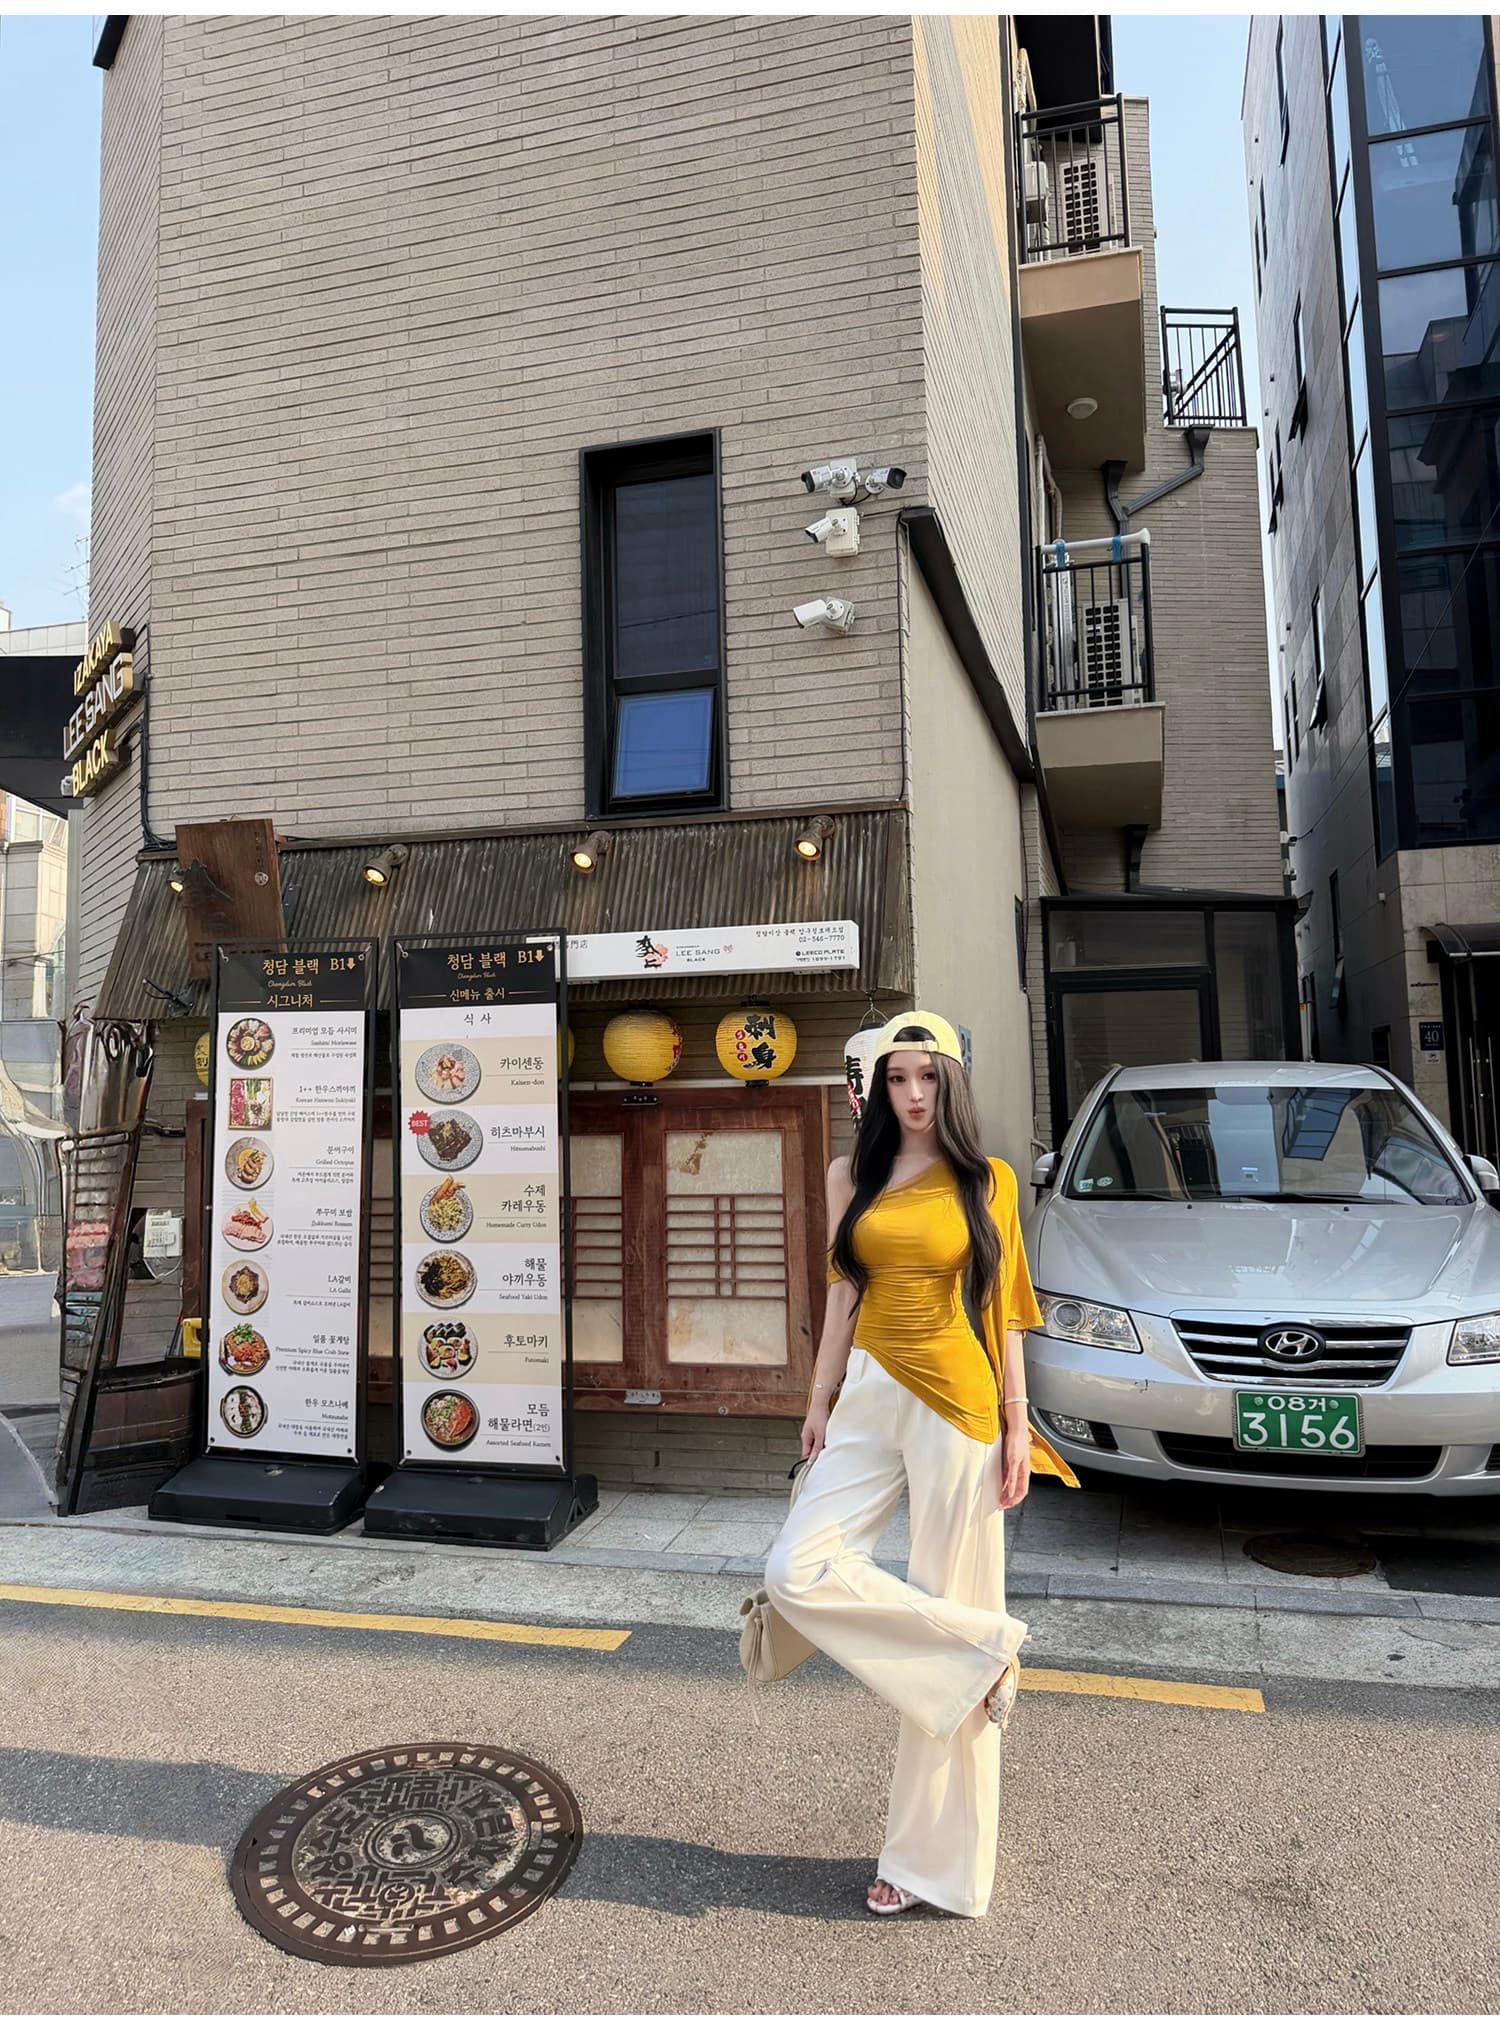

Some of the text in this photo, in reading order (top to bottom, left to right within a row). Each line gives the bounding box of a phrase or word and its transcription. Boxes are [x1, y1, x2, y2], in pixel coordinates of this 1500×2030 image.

[74, 621, 113, 695] IZAKAYA
[72, 729, 109, 797] BLACK
[695, 948, 720, 956] SANG
[263, 959, 345, 976] 청담 블랙 B1
[447, 951, 533, 971] 청담 블랙 B1
[450, 987, 505, 1002] 신메뉴 출시
[337, 1026, 357, 1035] 사시미
[1424, 1030, 1440, 1043] 40
[499, 1057, 544, 1071] 카이센동
[411, 1119, 429, 1127] BEST
[490, 1126, 545, 1139] 히츠마부시
[327, 1145, 354, 1155] 문어구이
[523, 1184, 546, 1197] 수제
[338, 1208, 352, 1217] 보쌈
[501, 1199, 546, 1214] 카레우동
[524, 1258, 547, 1270] 해물
[328, 1275, 351, 1284] LA갈비
[502, 1272, 547, 1287] 야끼우동
[503, 1334, 548, 1349] 후토마키
[305, 1398, 319, 1407] 한우
[1267, 1396, 1327, 1412] 08거
[1242, 1412, 1355, 1450] 3156
